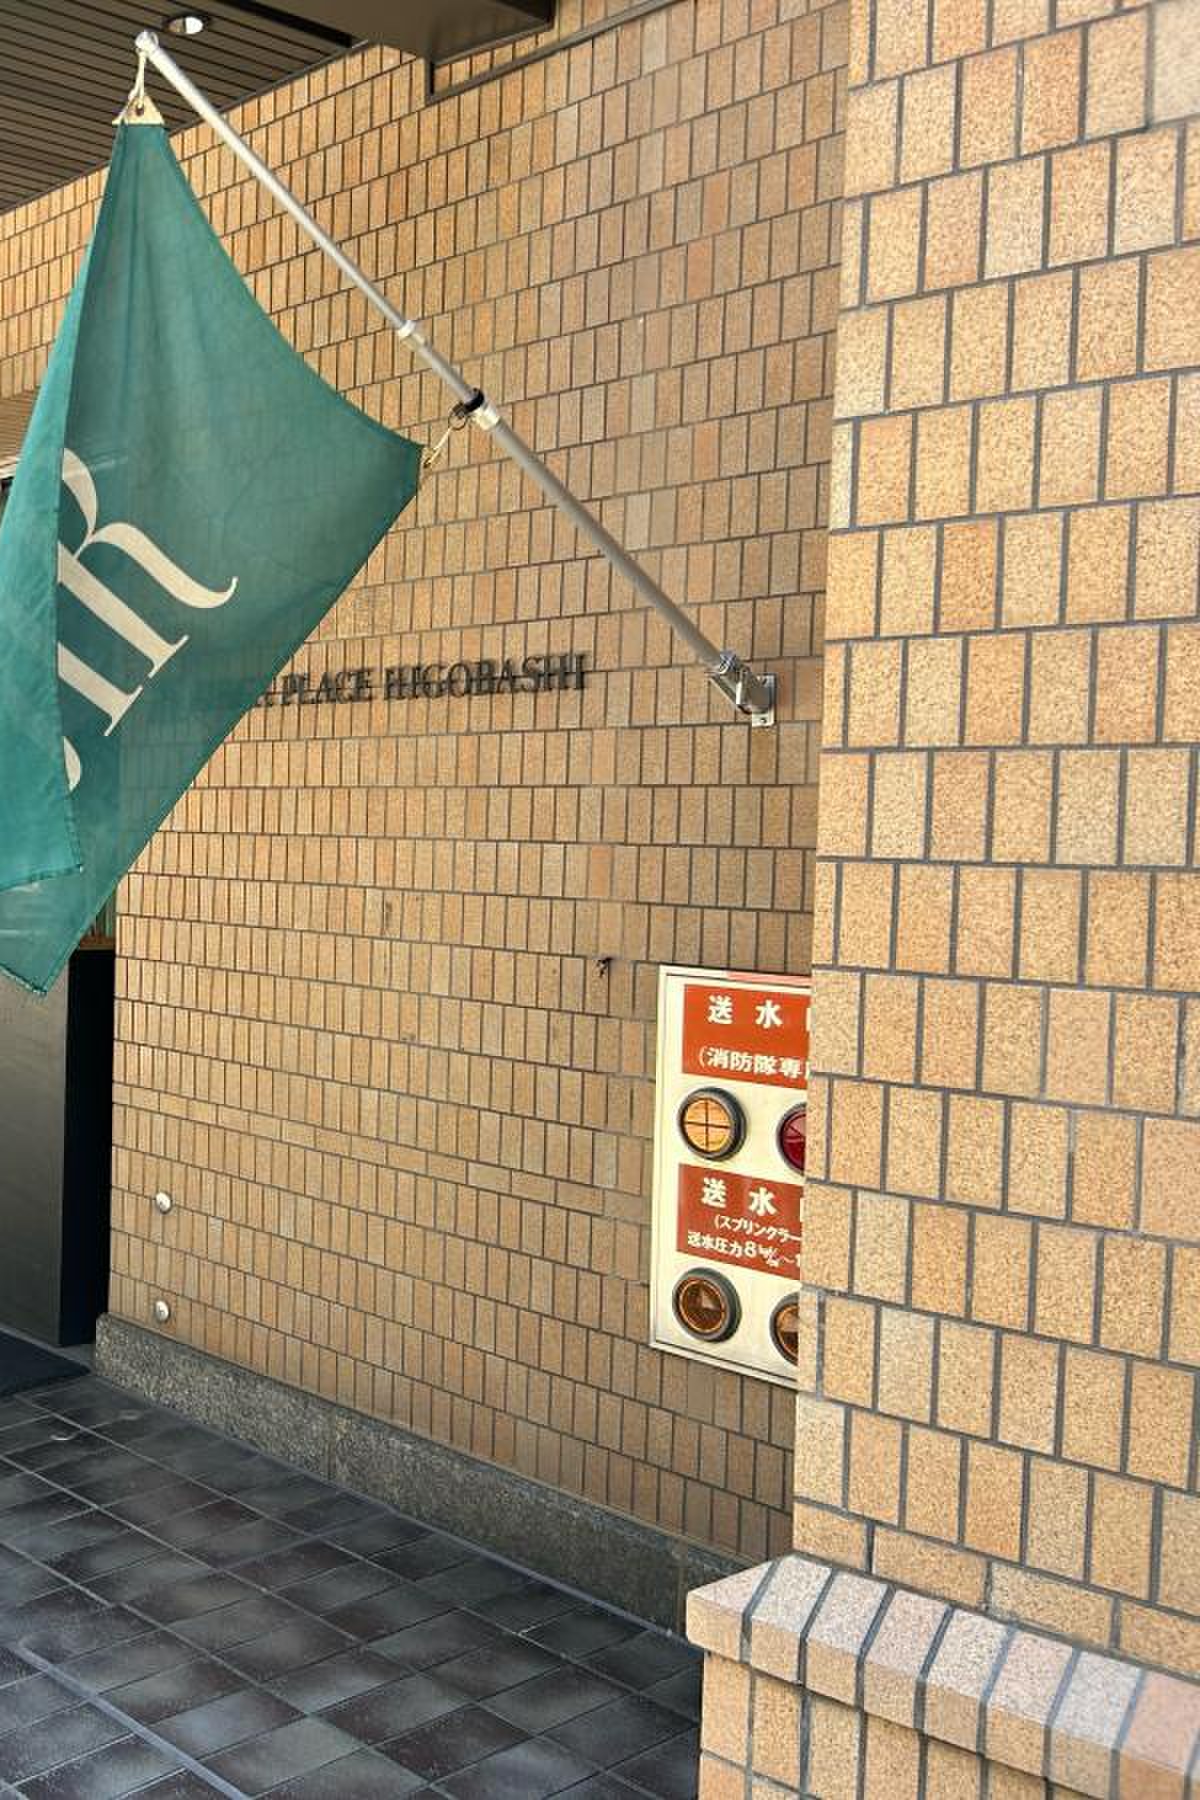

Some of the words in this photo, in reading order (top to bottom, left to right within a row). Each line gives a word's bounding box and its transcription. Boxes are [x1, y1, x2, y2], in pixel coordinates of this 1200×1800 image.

[280, 667, 373, 705] PLACE
[384, 653, 591, 701] HIGOBASHI
[706, 995, 810, 1029] 送水
[699, 1046, 810, 1080] (消防隊専
[701, 1177, 804, 1217] 送水
